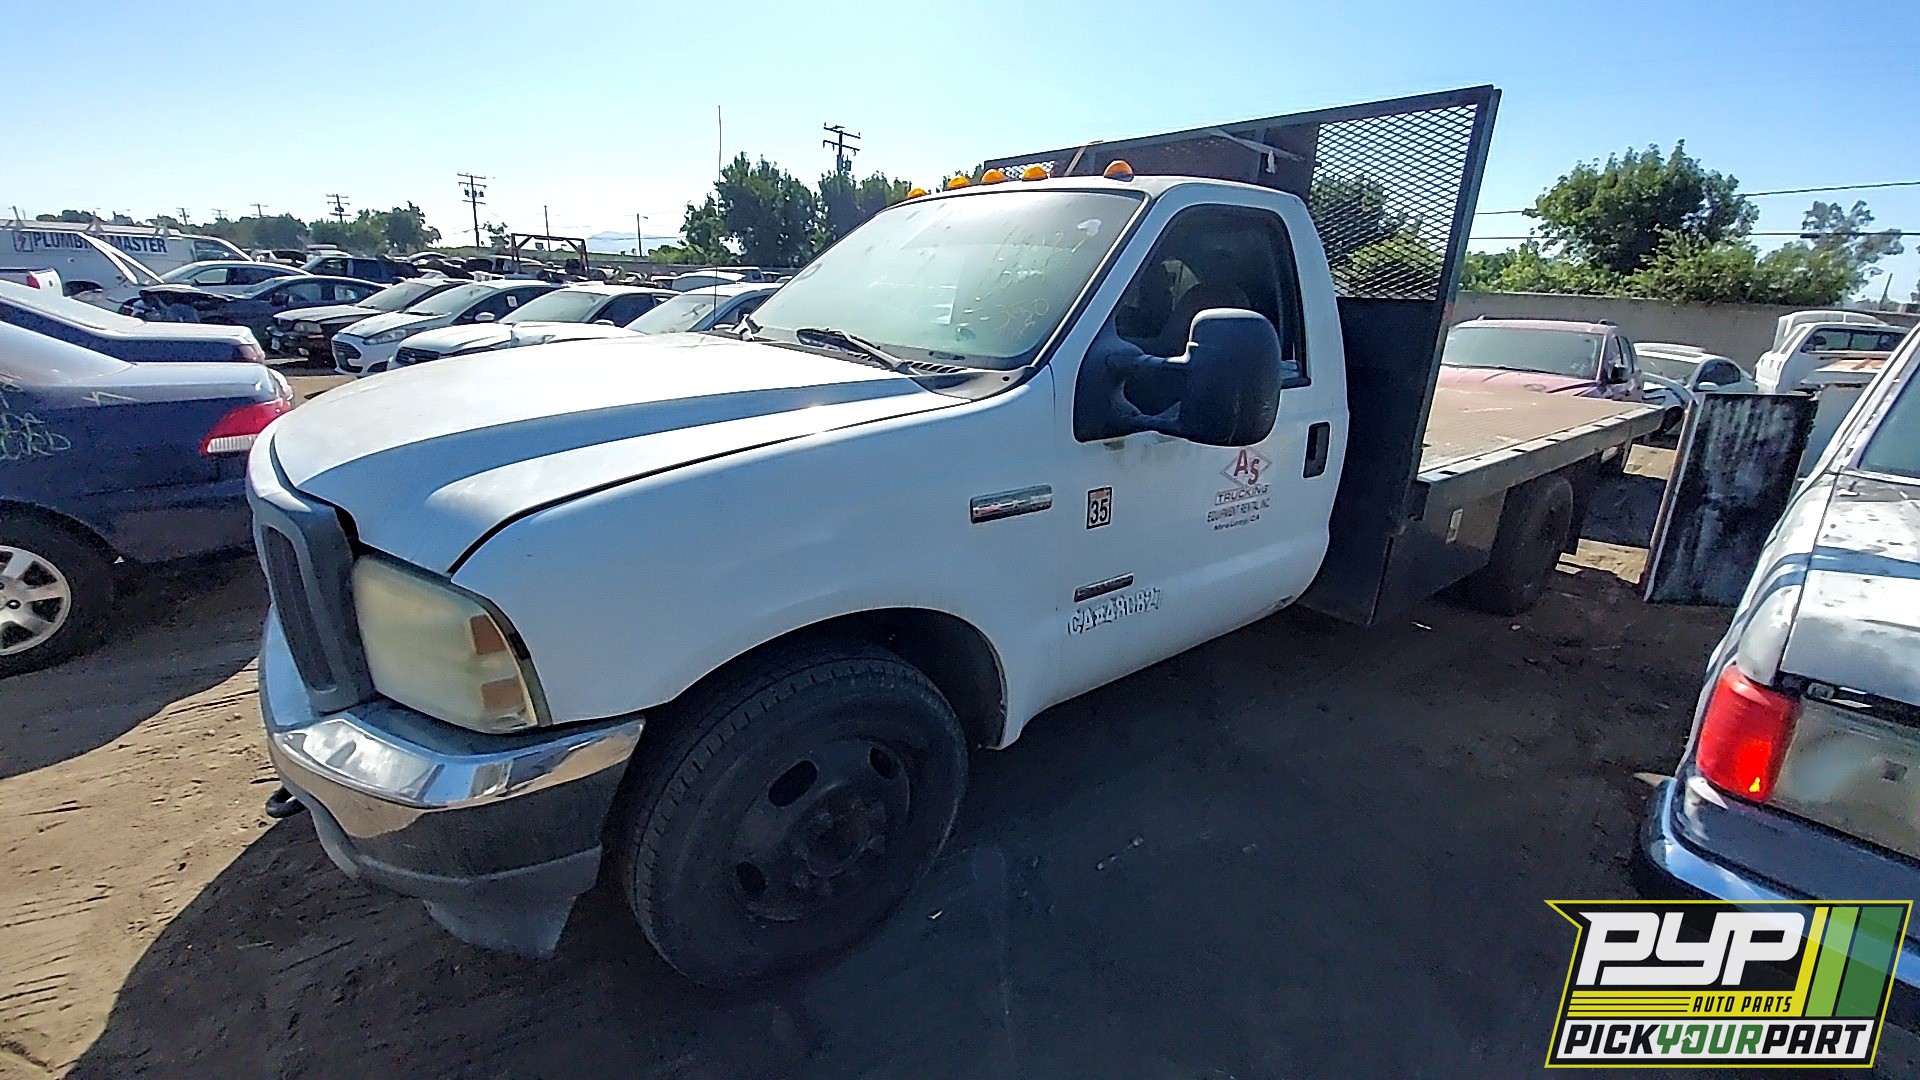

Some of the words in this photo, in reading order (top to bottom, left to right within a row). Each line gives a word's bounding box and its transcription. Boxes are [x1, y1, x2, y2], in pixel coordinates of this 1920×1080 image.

[34, 231, 105, 250] PLUMBI
[110, 236, 168, 254] MASTER
[1217, 484, 1270, 503] TRUCKING
[1090, 498, 1109, 525] 35
